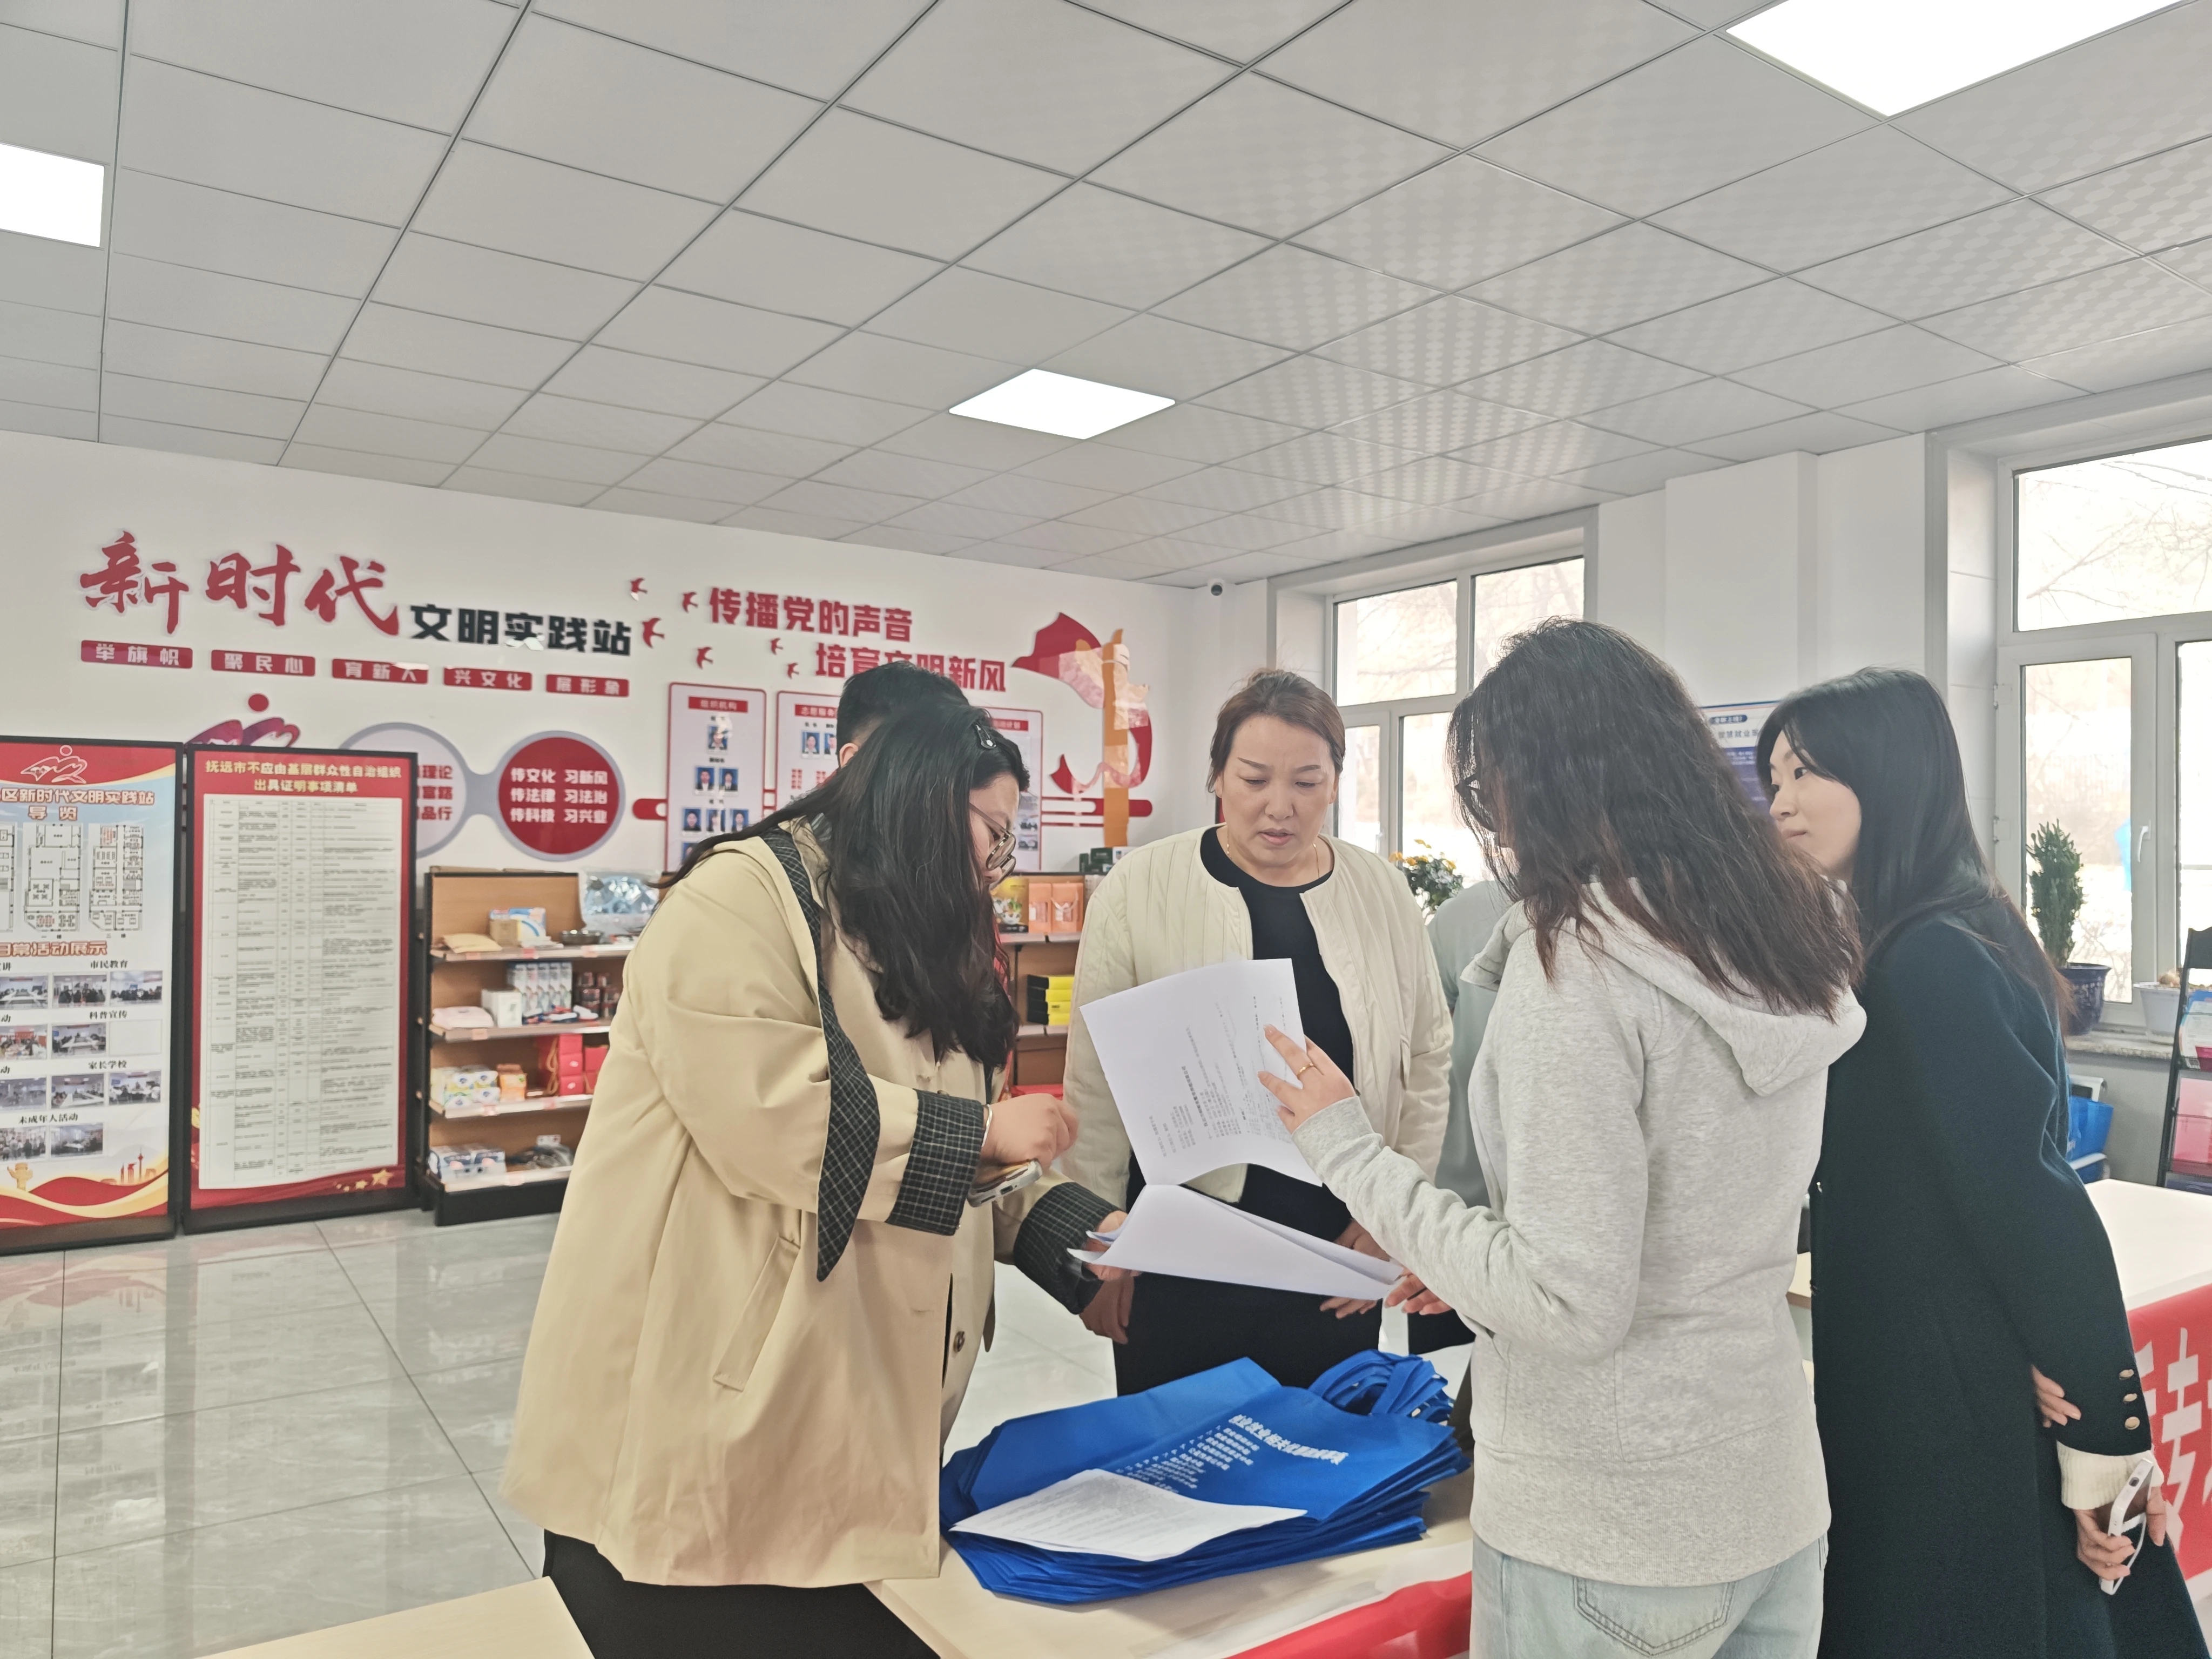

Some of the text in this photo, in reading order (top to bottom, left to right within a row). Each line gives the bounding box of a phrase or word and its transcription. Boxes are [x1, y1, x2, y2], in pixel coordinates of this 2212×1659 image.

[79, 530, 631, 656] 新时代 文明实践站
[709, 586, 912, 643] 传播党的声音
[96, 643, 179, 665] 举旗帜
[224, 652, 304, 674] 聚民心
[454, 669, 523, 688] 兴文化
[205, 760, 402, 778] 抚远市不应由基层群众性自治组织
[418, 764, 453, 779] 理论
[510, 767, 557, 783] 传文化
[254, 778, 358, 793] 出具证明事项清单
[0, 788, 155, 805] 区新时代文明实践站
[510, 788, 608, 804] 传法律 习法治
[28, 806, 78, 820] 导览
[418, 806, 453, 820] 品行
[0, 941, 107, 957] 日常活动展示
[0, 961, 11, 971] 讲
[90, 959, 129, 969] 市民教育
[89, 1010, 127, 1020] 科普宣传
[88, 1060, 127, 1069] 家长学校
[18, 1112, 78, 1124] 未成年人活动
